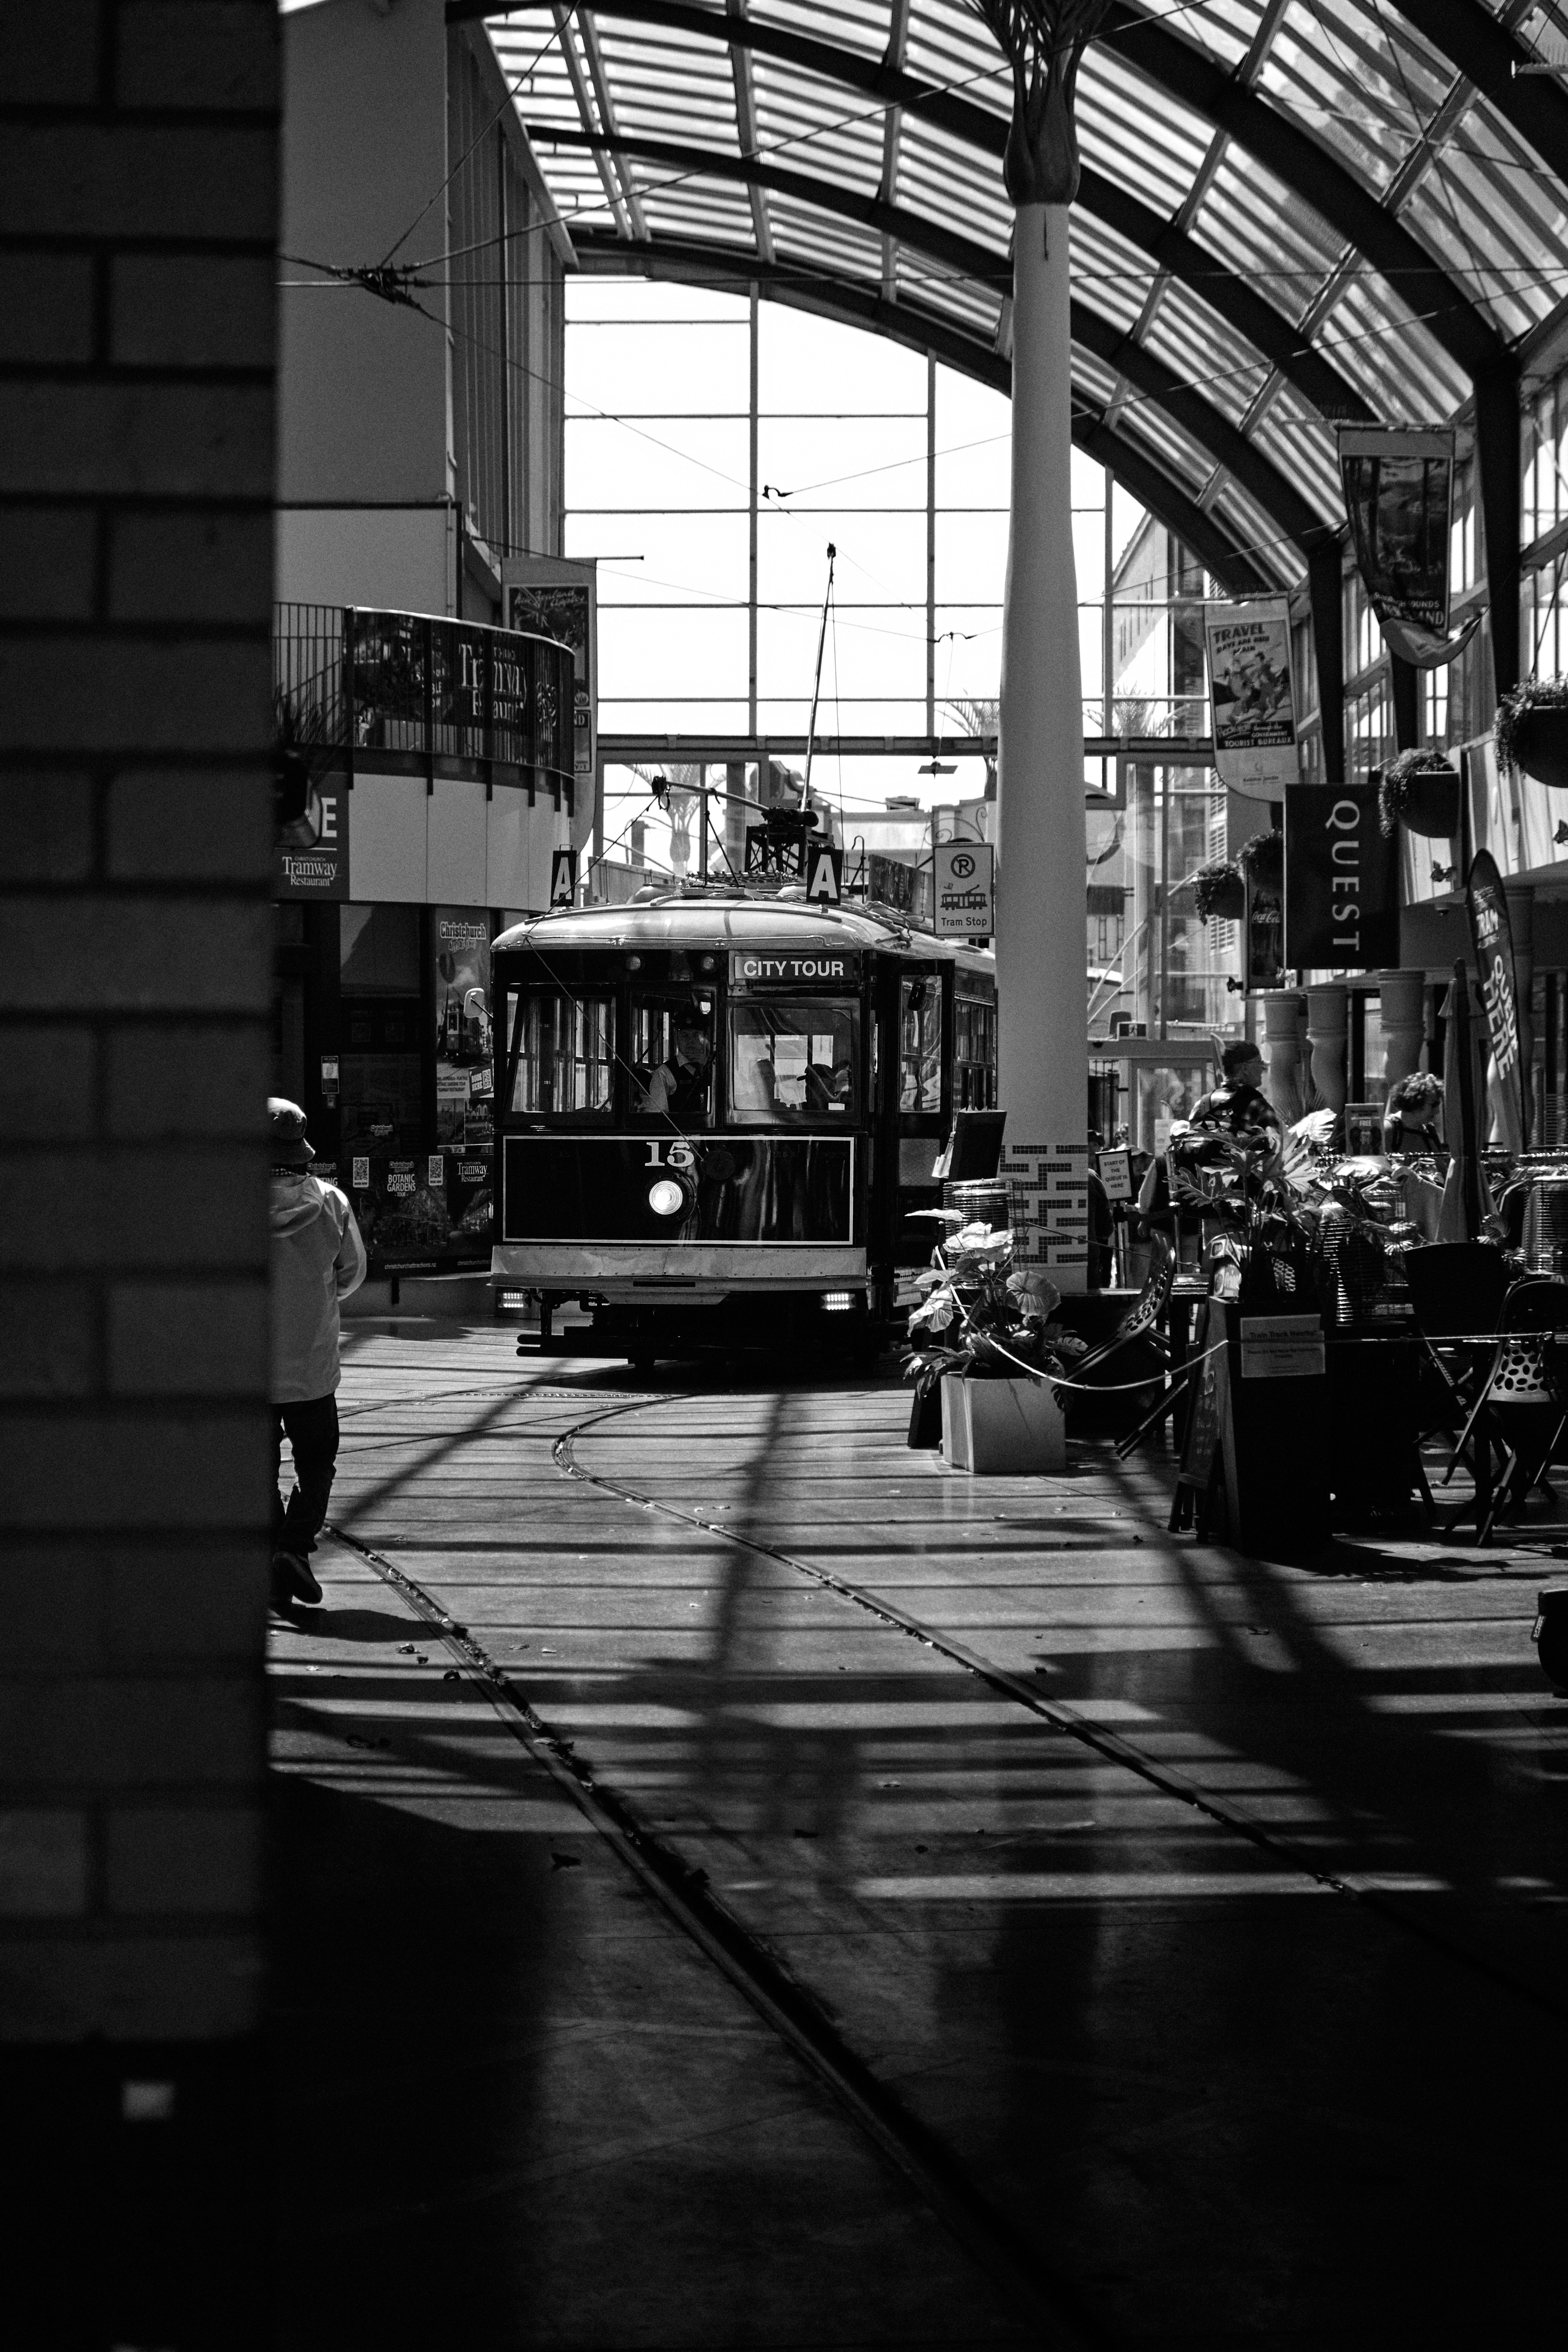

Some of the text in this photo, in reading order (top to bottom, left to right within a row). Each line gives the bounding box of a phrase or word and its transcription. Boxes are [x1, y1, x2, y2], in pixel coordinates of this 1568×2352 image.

[1214, 624, 1265, 643] TRAVEL
[1238, 637, 1251, 646] ARE
[1258, 737, 1292, 745] BUREAUX
[282, 856, 337, 881] Tramway
[553, 856, 572, 900] A
[809, 854, 838, 899] A
[1325, 800, 1360, 952] QUEST
[290, 874, 330, 886] Restaurant
[440, 921, 486, 940] Christchurch
[941, 917, 987, 927] Tram Stop
[1476, 909, 1499, 939] TRAM
[744, 961, 844, 976] CITY TOUR
[1494, 955, 1519, 1050] QUEUE
[1483, 969, 1514, 1080] HERE
[644, 1141, 695, 1167] 15
[307, 1162, 337, 1170] Christchurch
[457, 1162, 488, 1178] Tramway
[387, 1183, 416, 1192] GARDENS
[388, 1174, 415, 1183] BOTANIC
